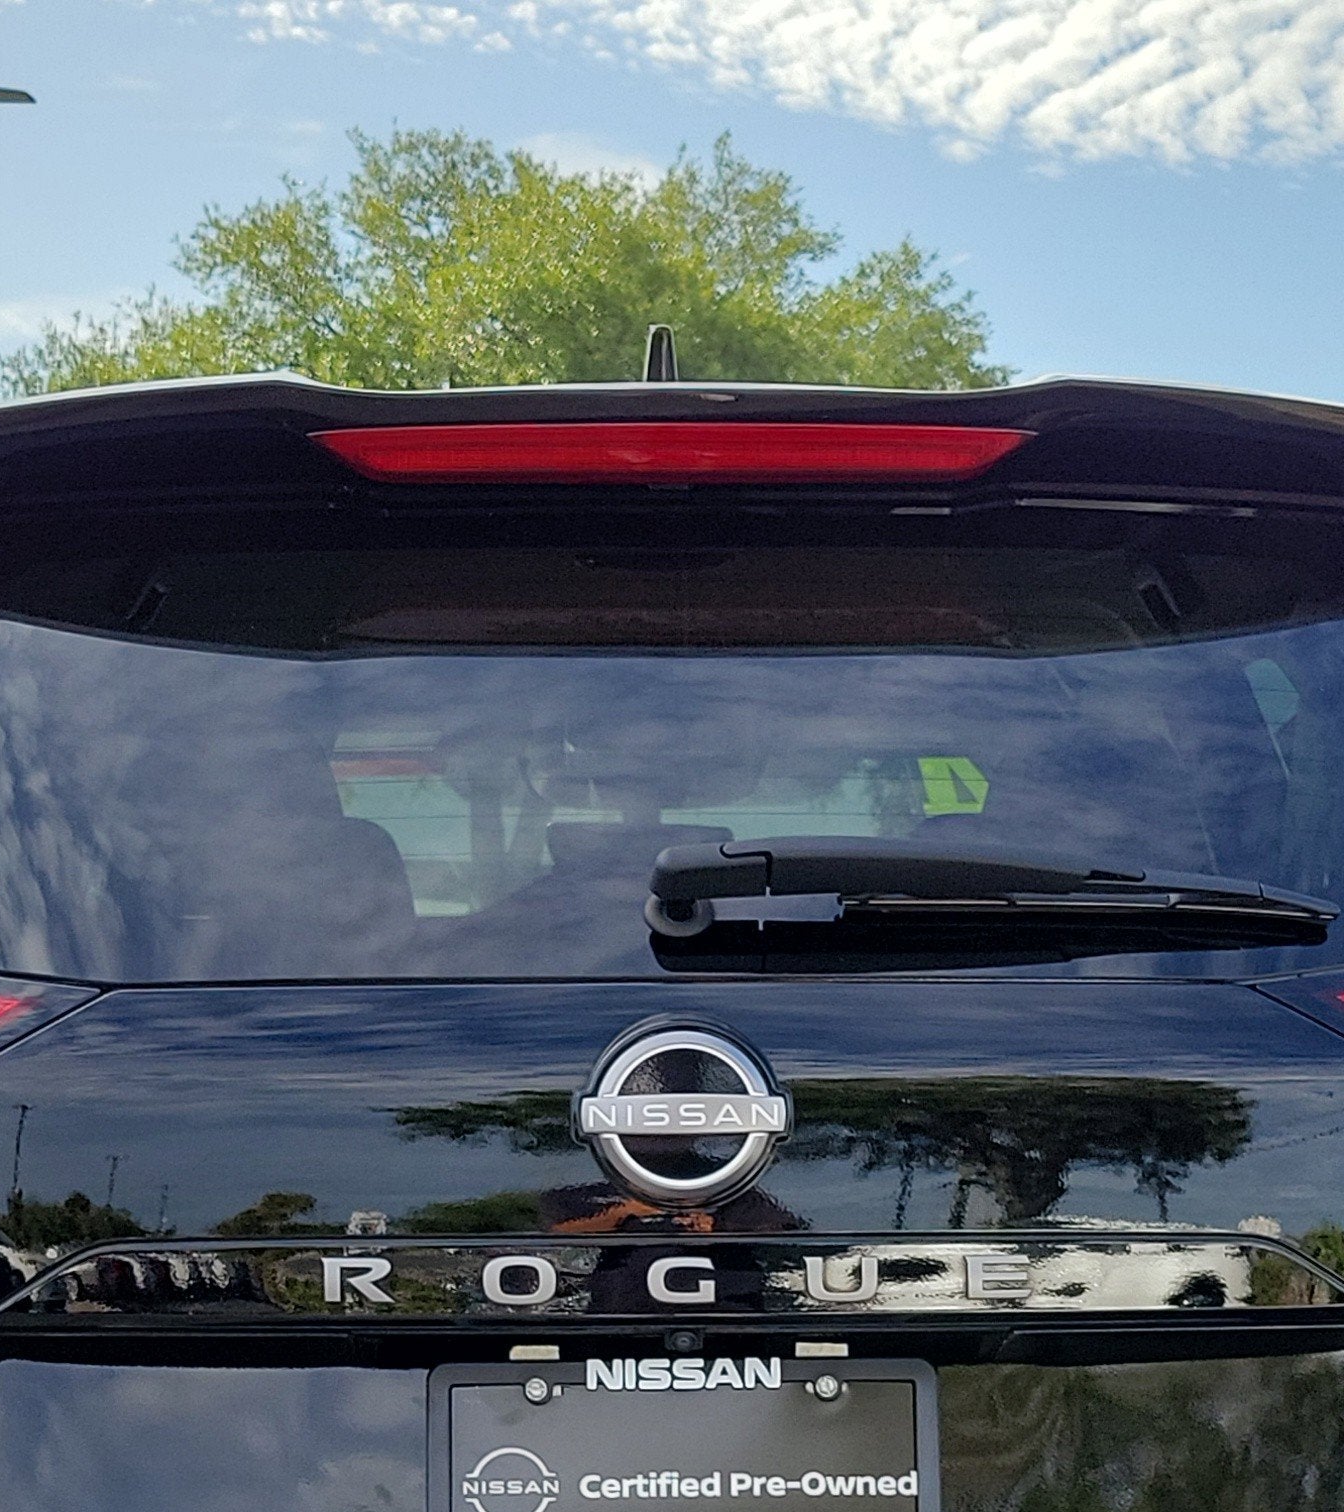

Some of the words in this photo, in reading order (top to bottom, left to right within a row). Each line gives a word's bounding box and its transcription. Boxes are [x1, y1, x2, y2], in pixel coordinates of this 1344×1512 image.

[588, 1102, 780, 1128] NISSAN
[319, 1253, 1032, 1305] ROGUE
[585, 1357, 782, 1391] NISSAN
[461, 1479, 560, 1496] NISSAN
[578, 1470, 722, 1499] Certified
[729, 1470, 919, 1497] Pre-Owned
